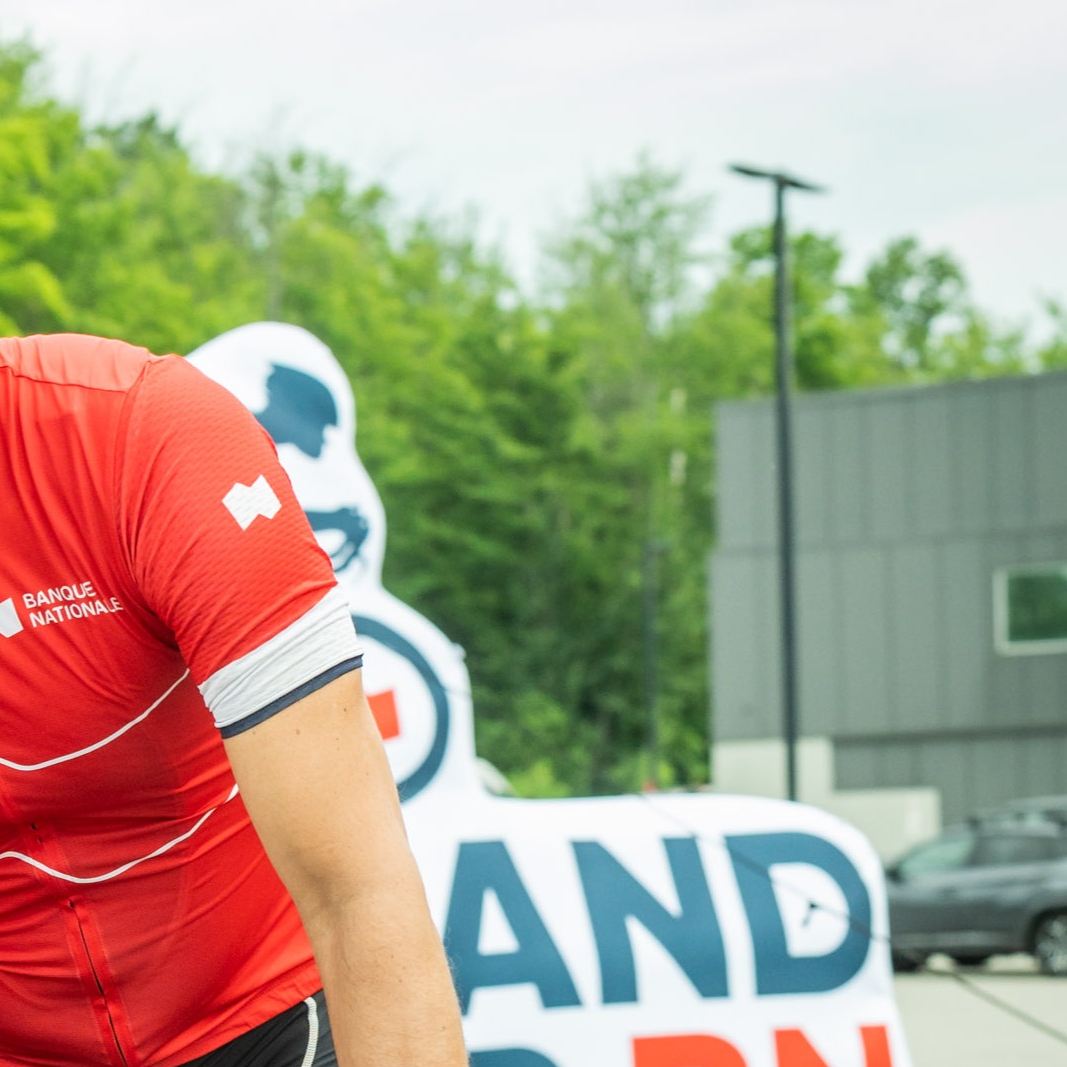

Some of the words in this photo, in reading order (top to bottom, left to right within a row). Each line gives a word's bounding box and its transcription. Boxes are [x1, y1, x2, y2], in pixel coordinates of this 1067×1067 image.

[22, 581, 96, 609] BANQUE
[29, 597, 123, 628] NATIONALE
[443, 831, 873, 1016] AND
